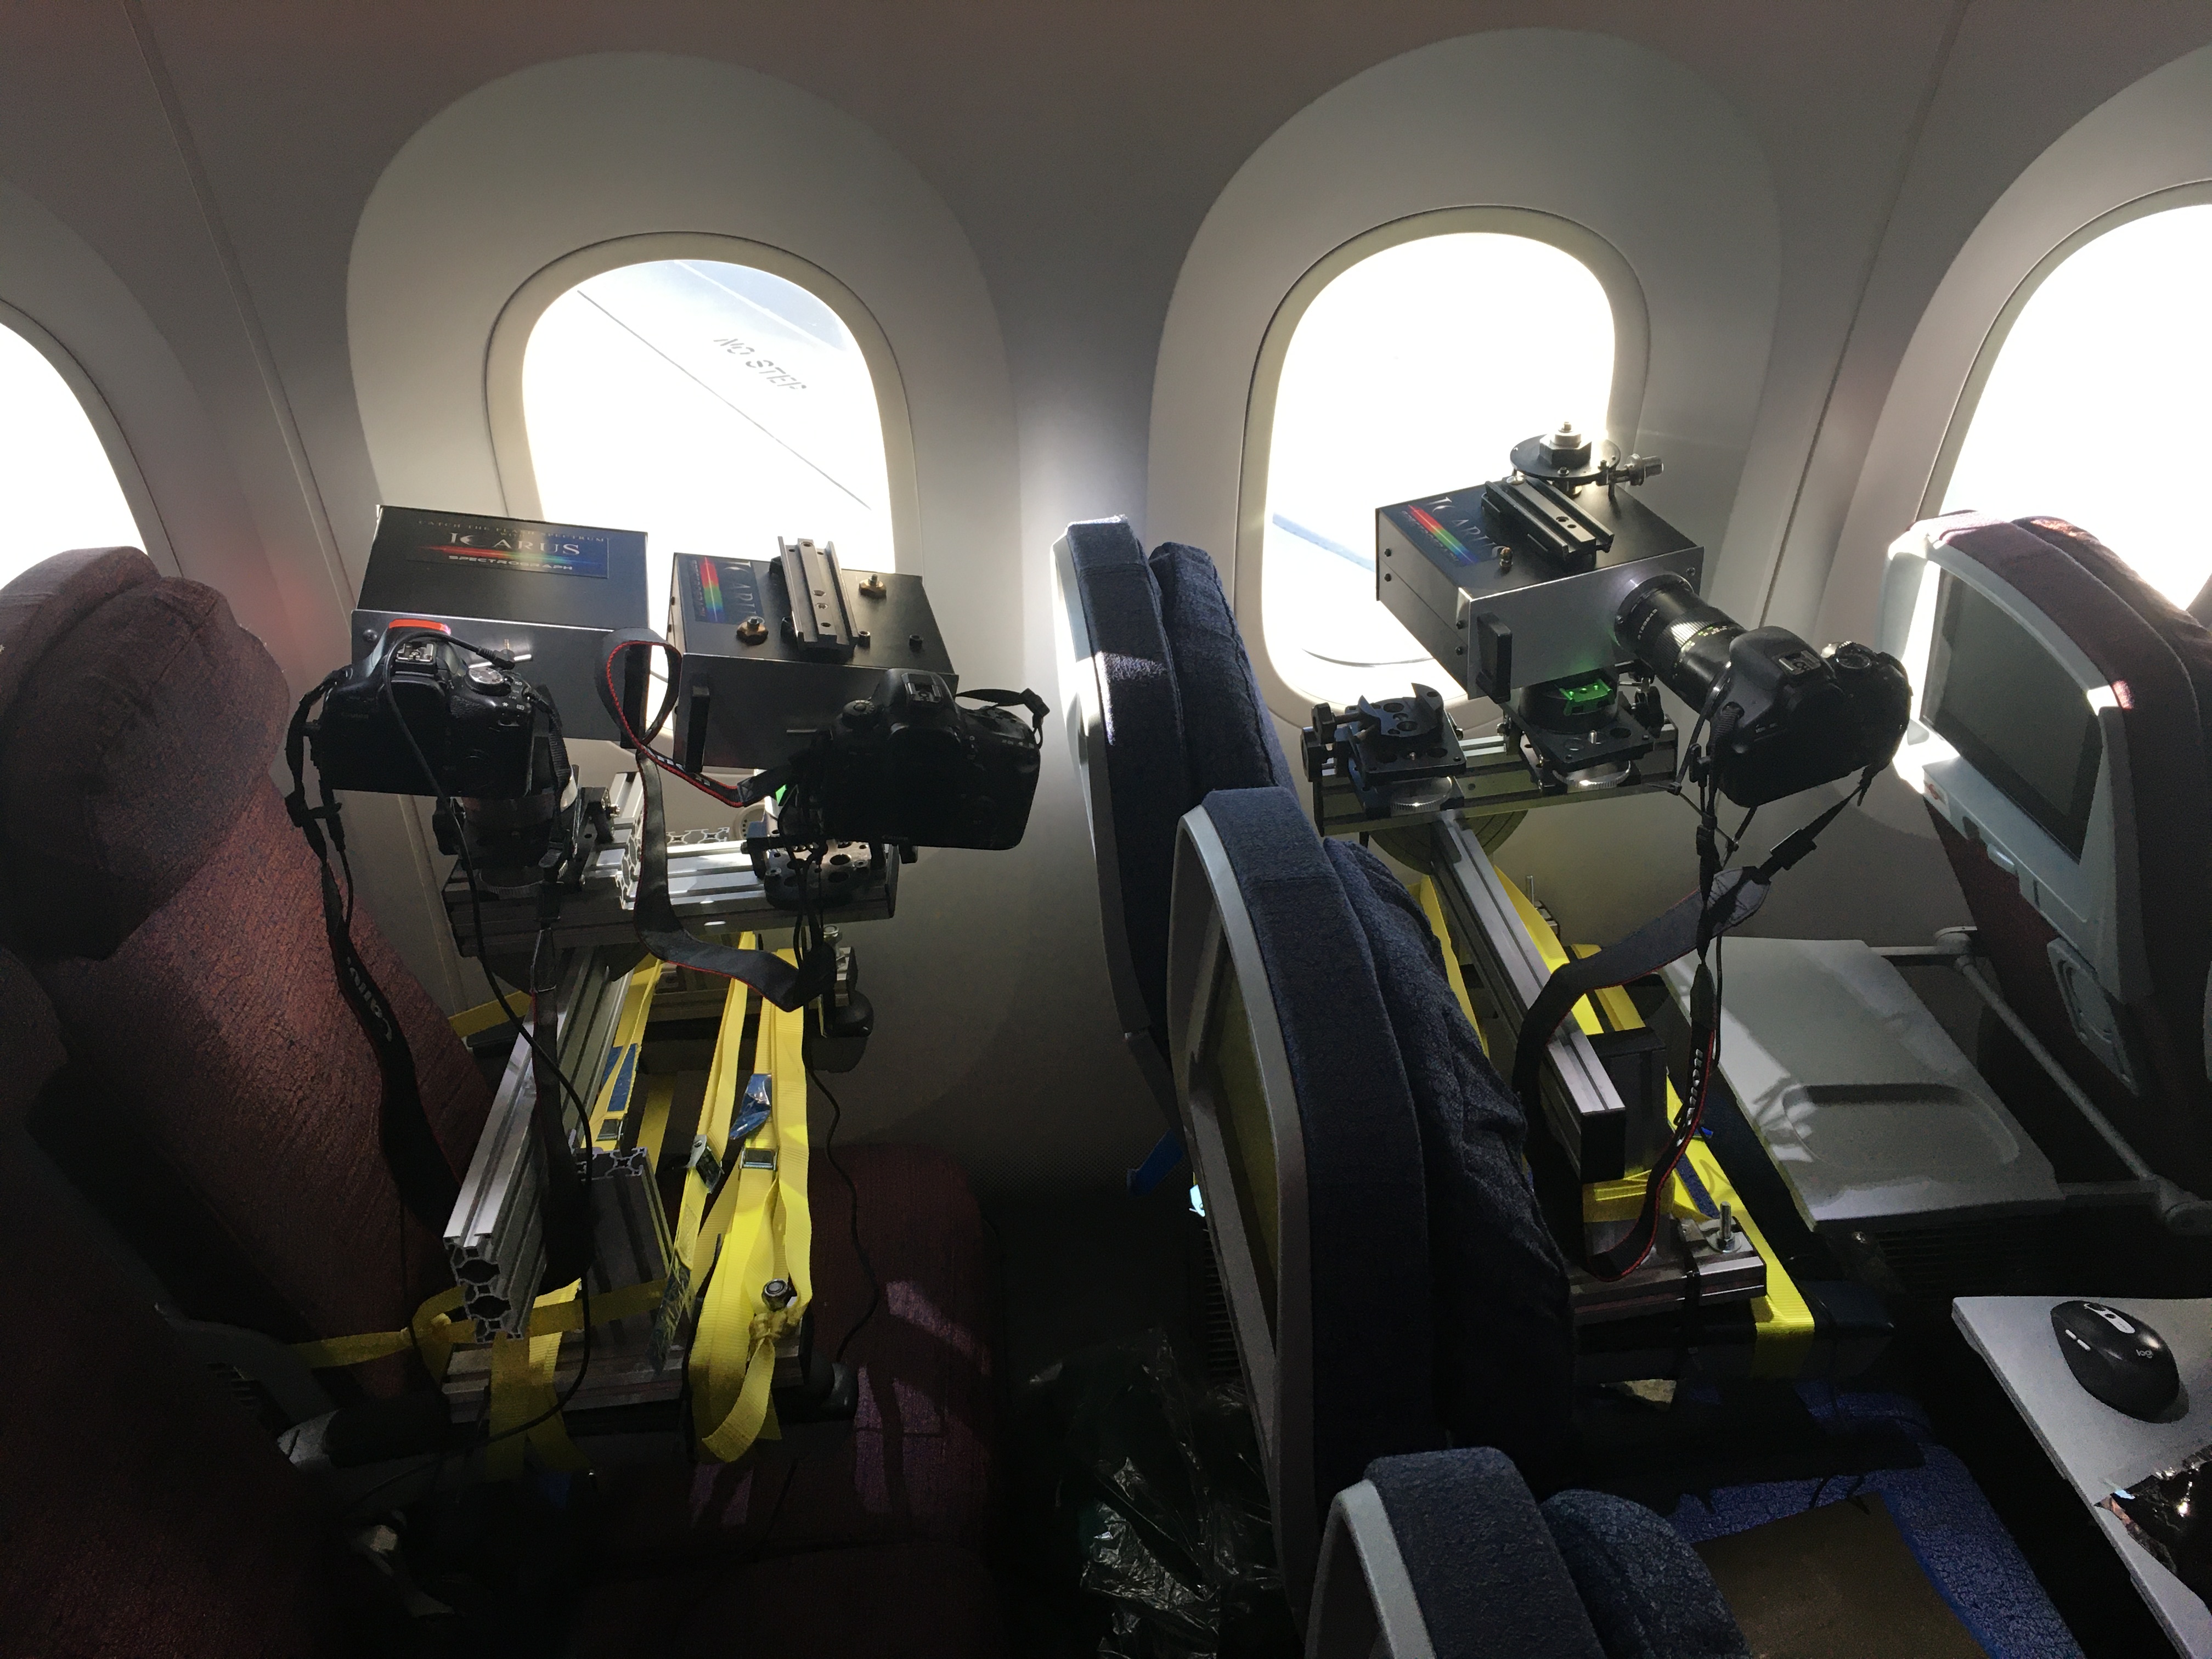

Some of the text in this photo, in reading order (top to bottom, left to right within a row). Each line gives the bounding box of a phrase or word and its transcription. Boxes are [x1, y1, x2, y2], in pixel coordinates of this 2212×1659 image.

[713, 338, 807, 390] NO STEP
[449, 532, 580, 555] ICARUS
[541, 532, 604, 542] SPECTRUM
[448, 555, 573, 571] SPECTROGRAPH
[346, 956, 393, 1042] Cano
